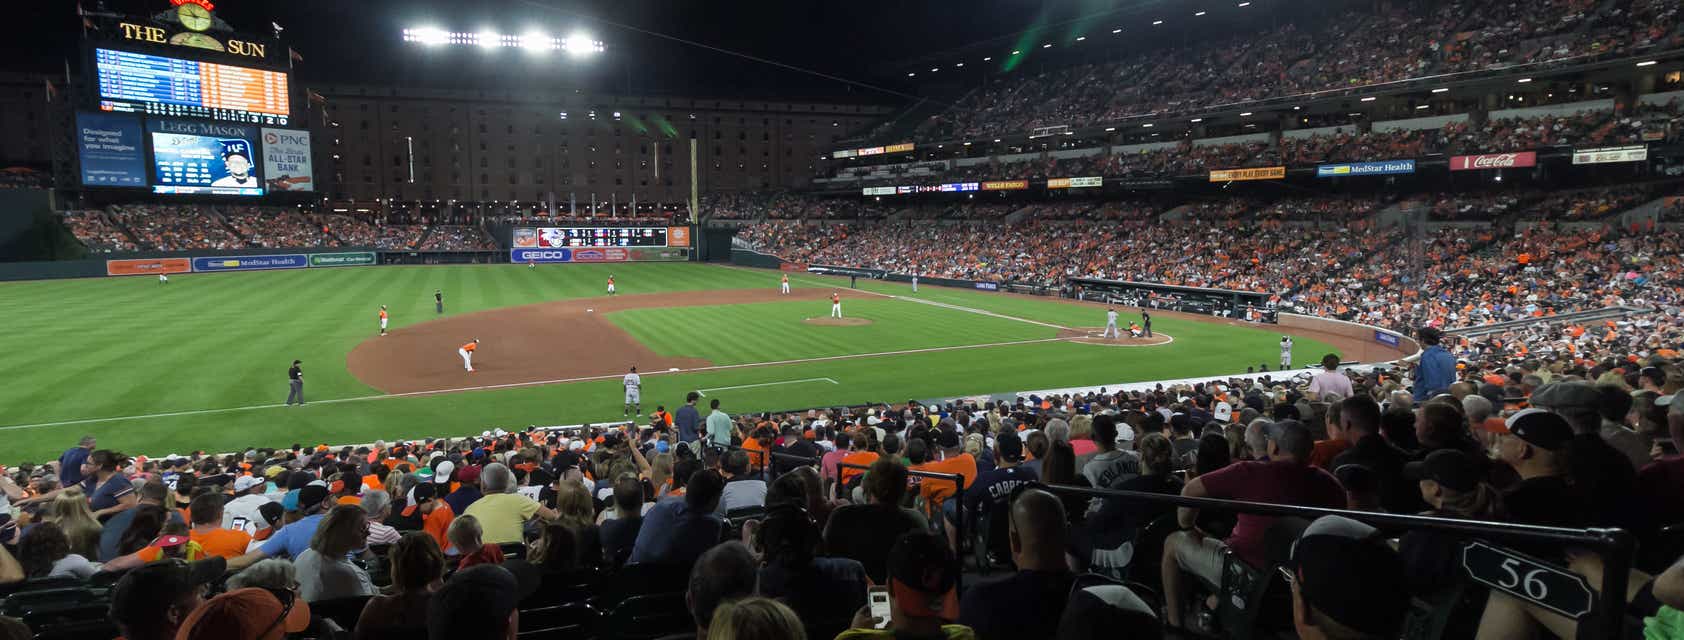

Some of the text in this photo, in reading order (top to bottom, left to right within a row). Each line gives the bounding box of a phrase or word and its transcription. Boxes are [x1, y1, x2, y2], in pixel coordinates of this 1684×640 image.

[120, 22, 265, 58] THE SUN
[83, 128, 122, 137] Designed
[160, 120, 246, 136] LEGG MASON
[280, 135, 308, 145] PNC
[269, 154, 307, 164] ALL-STAR
[1474, 153, 1520, 168] Coca-Cola
[277, 163, 299, 172] BANK
[1351, 163, 1413, 173] MedStar Health
[522, 251, 563, 259] GEICO
[1497, 558, 1548, 600] 56
